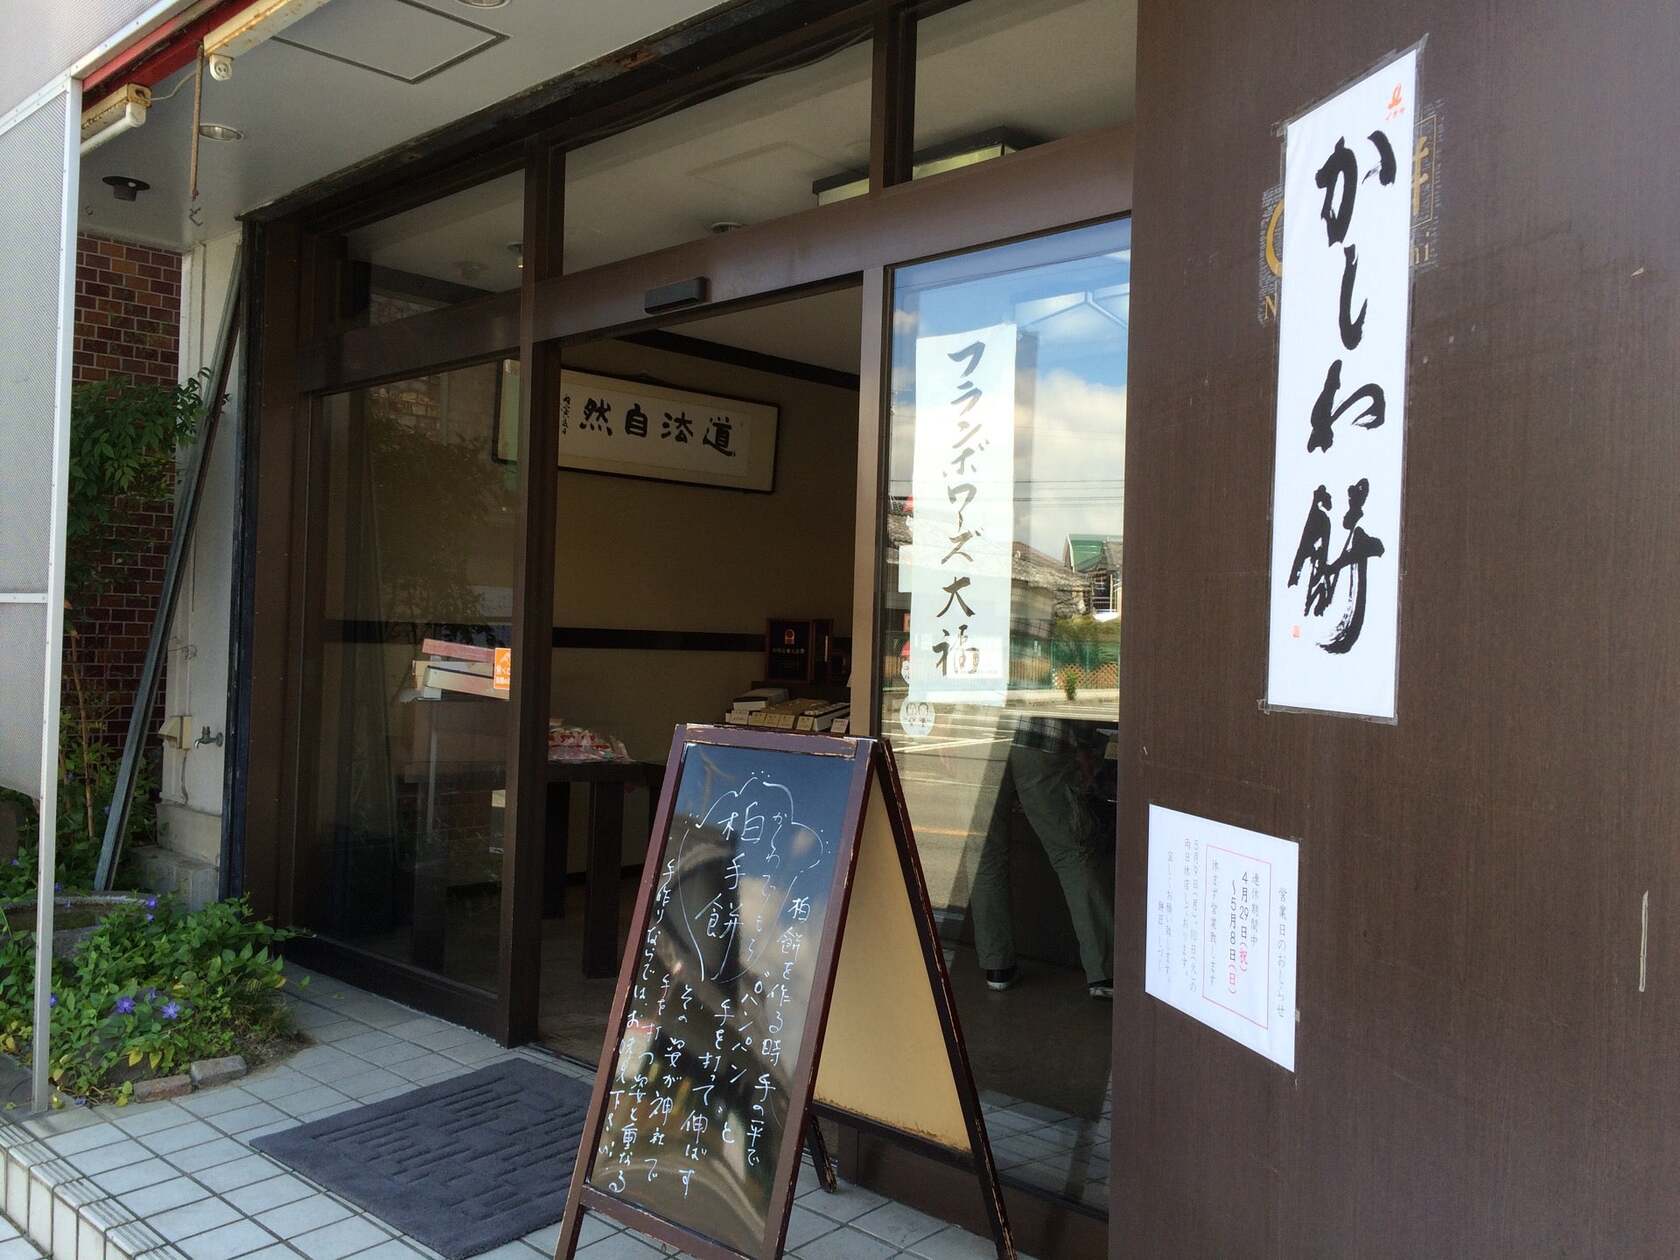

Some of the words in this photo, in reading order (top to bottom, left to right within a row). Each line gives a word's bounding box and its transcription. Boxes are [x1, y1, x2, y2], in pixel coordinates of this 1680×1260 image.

[932, 341, 989, 676] フランボワーズ大福
[1288, 130, 1397, 654] かしわ餅
